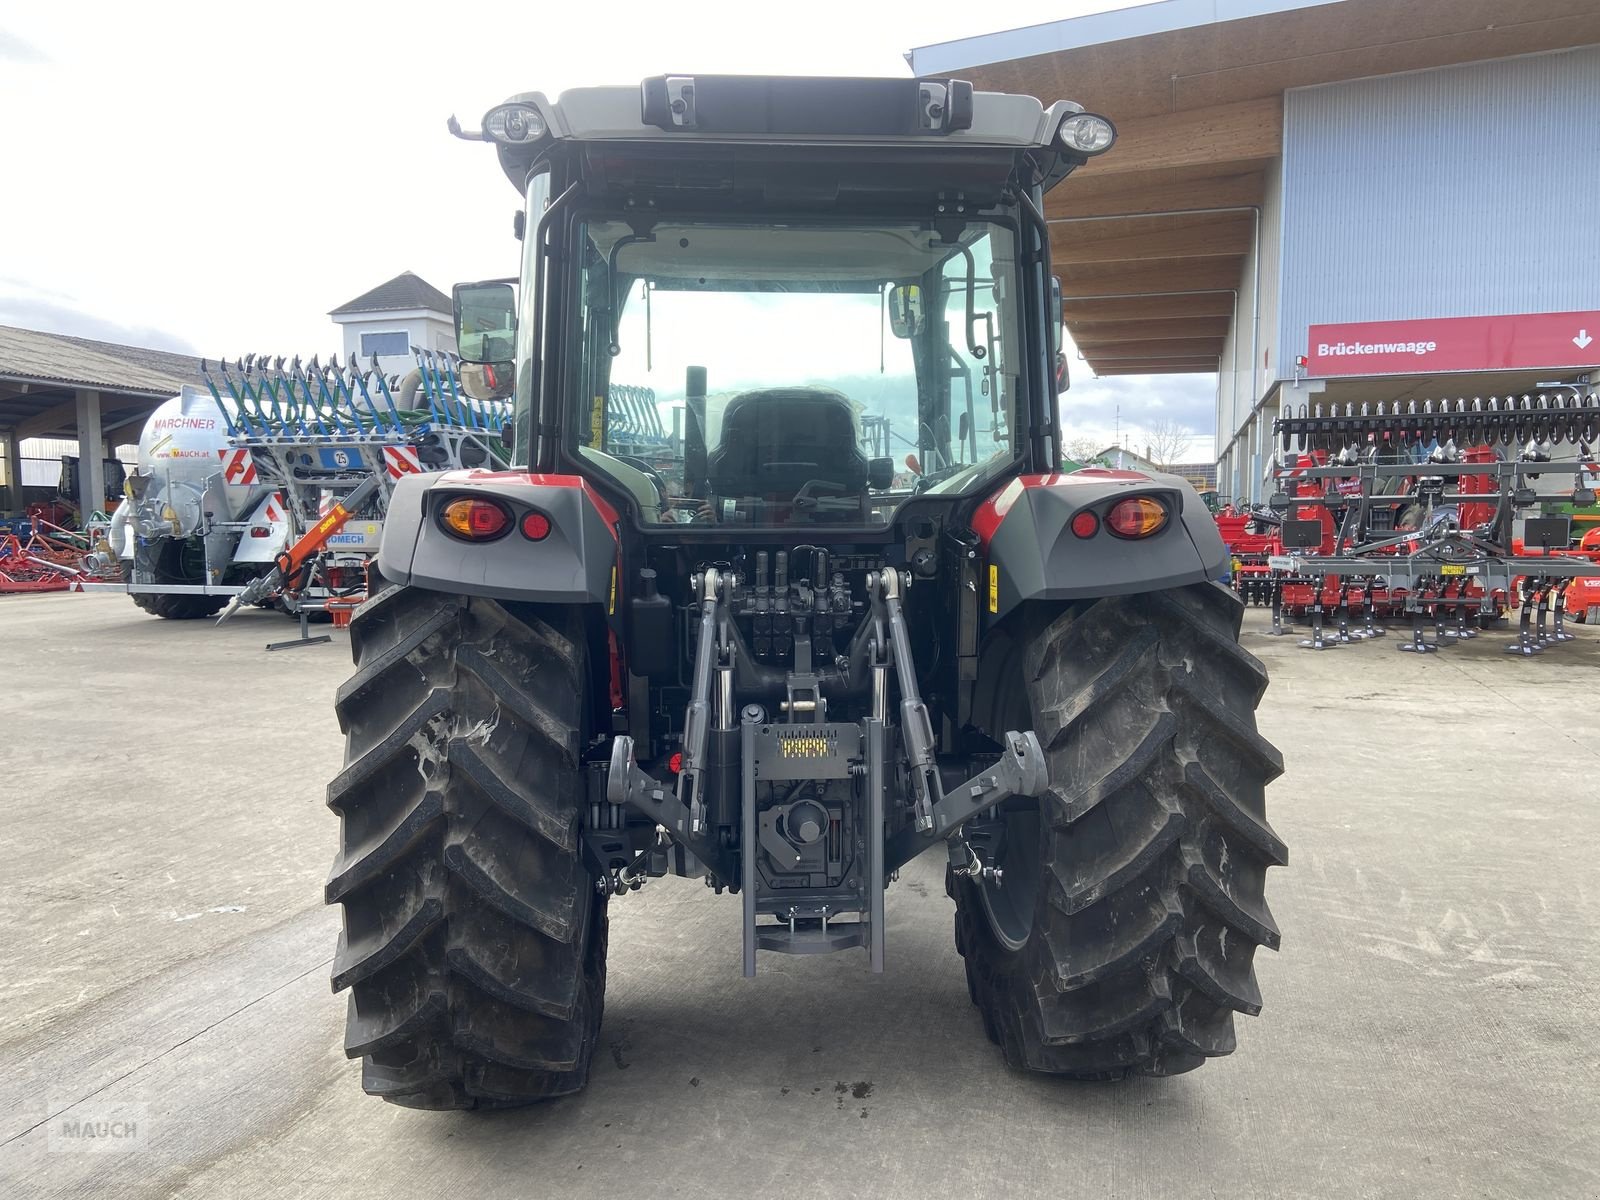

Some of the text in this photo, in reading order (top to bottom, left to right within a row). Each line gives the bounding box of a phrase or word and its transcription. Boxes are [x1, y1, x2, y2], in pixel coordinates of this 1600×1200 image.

[1317, 340, 1437, 356] Brückenwaage
[154, 418, 216, 430] MARCHNER
[156, 450, 210, 459] www.MAUCH.at
[335, 453, 347, 464] 25
[327, 535, 364, 544] OMECH
